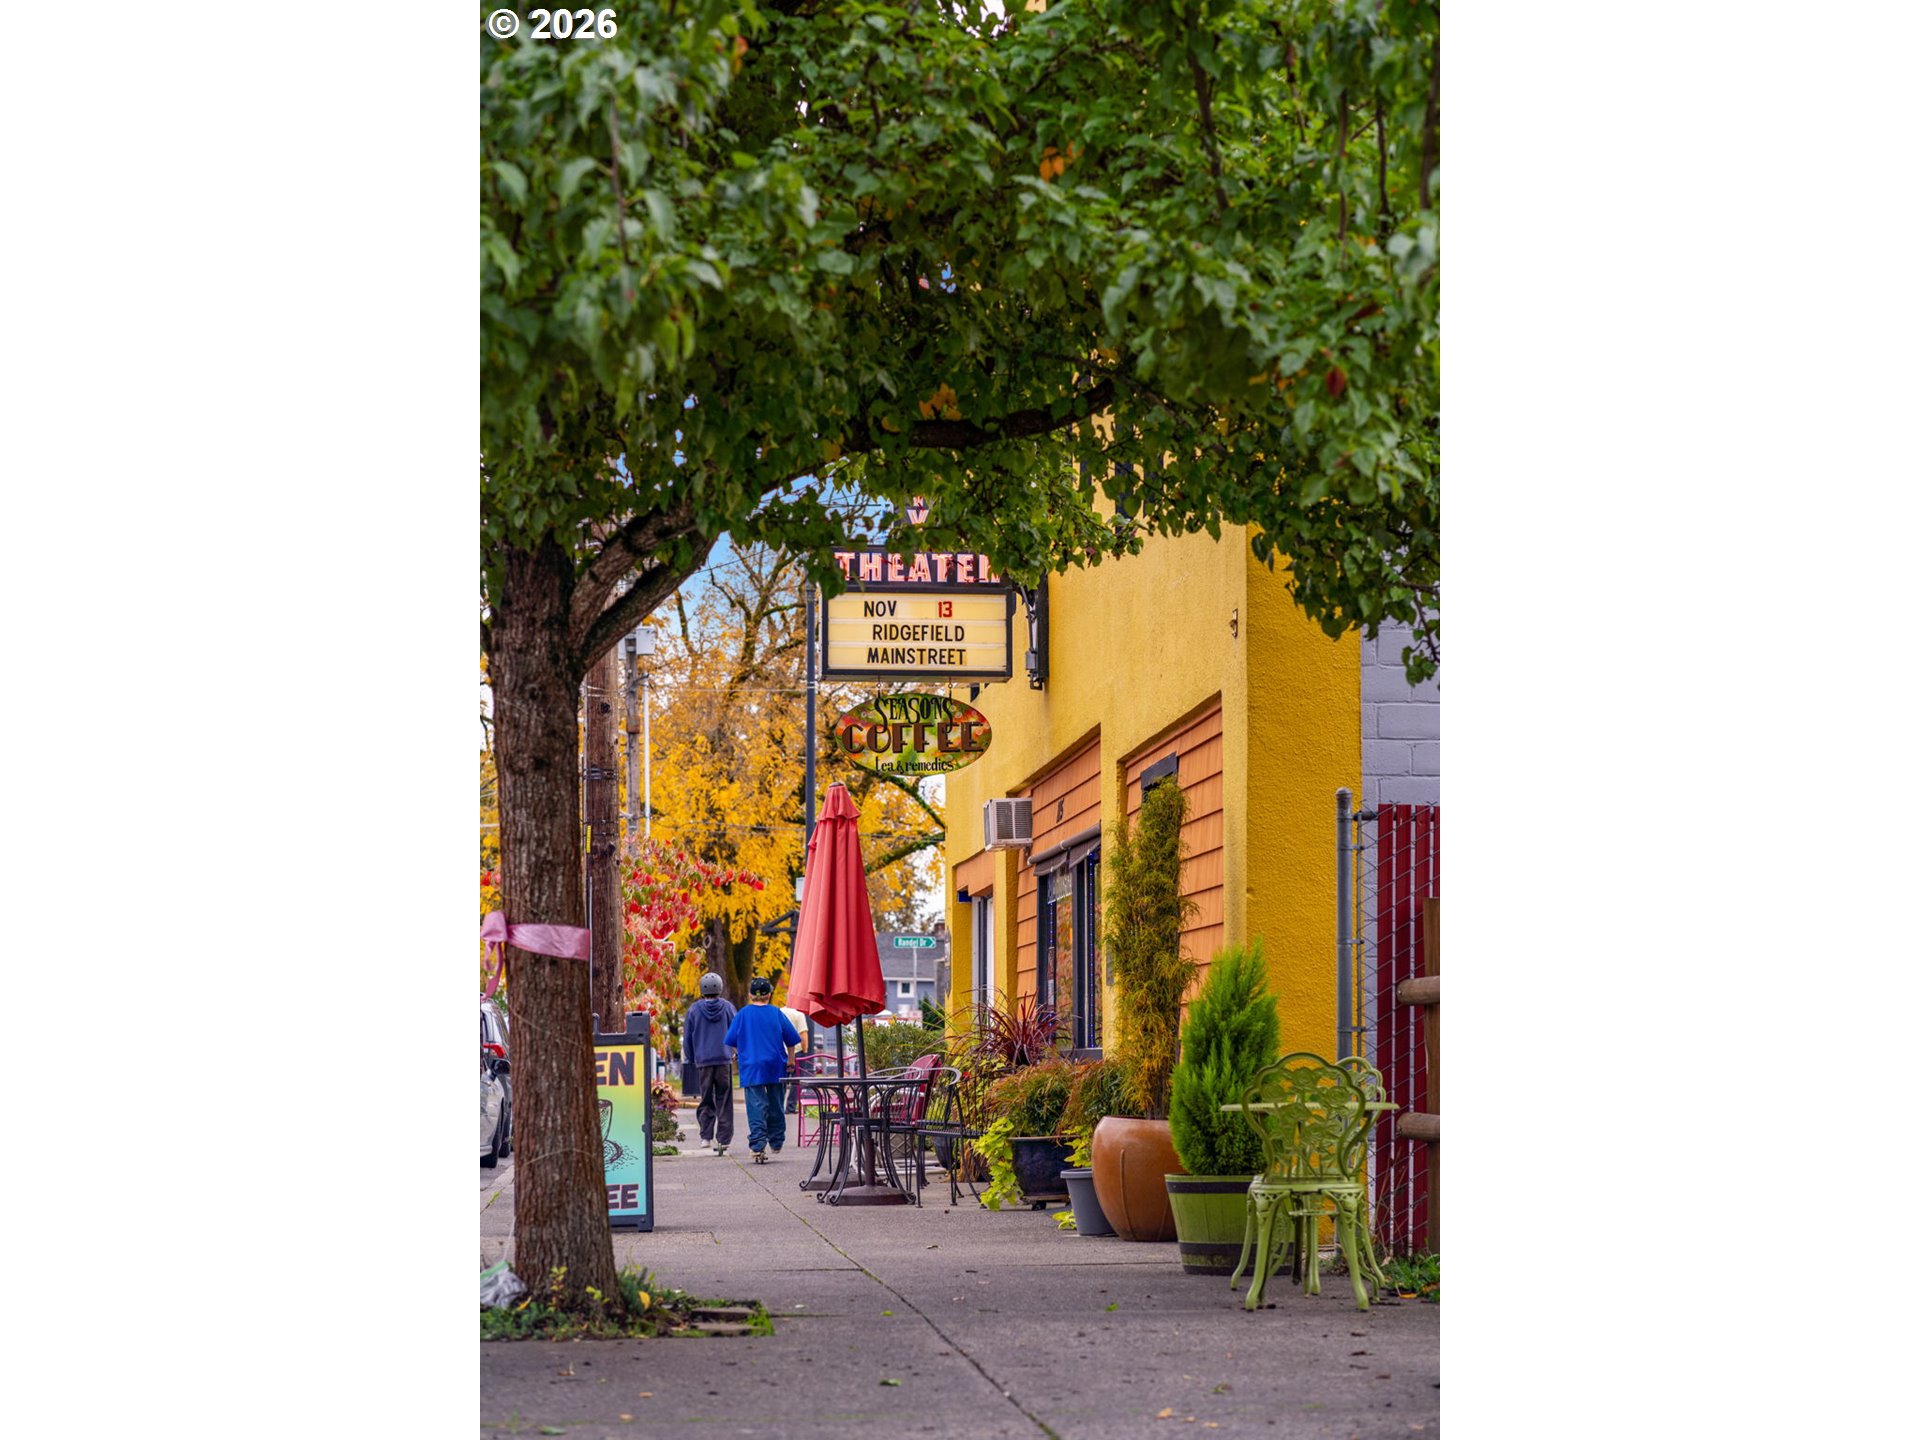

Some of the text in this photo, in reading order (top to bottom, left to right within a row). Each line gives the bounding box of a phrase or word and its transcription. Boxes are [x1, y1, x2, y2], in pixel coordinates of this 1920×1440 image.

[863, 600, 953, 618] NOV 13
[872, 624, 965, 642] RIDGEFIELD
[867, 648, 966, 665] MAINSTREET
[873, 696, 955, 734] SEASONS
[841, 721, 985, 754] COFFEE
[875, 756, 954, 775] tea & remedies
[594, 1051, 635, 1087] EN
